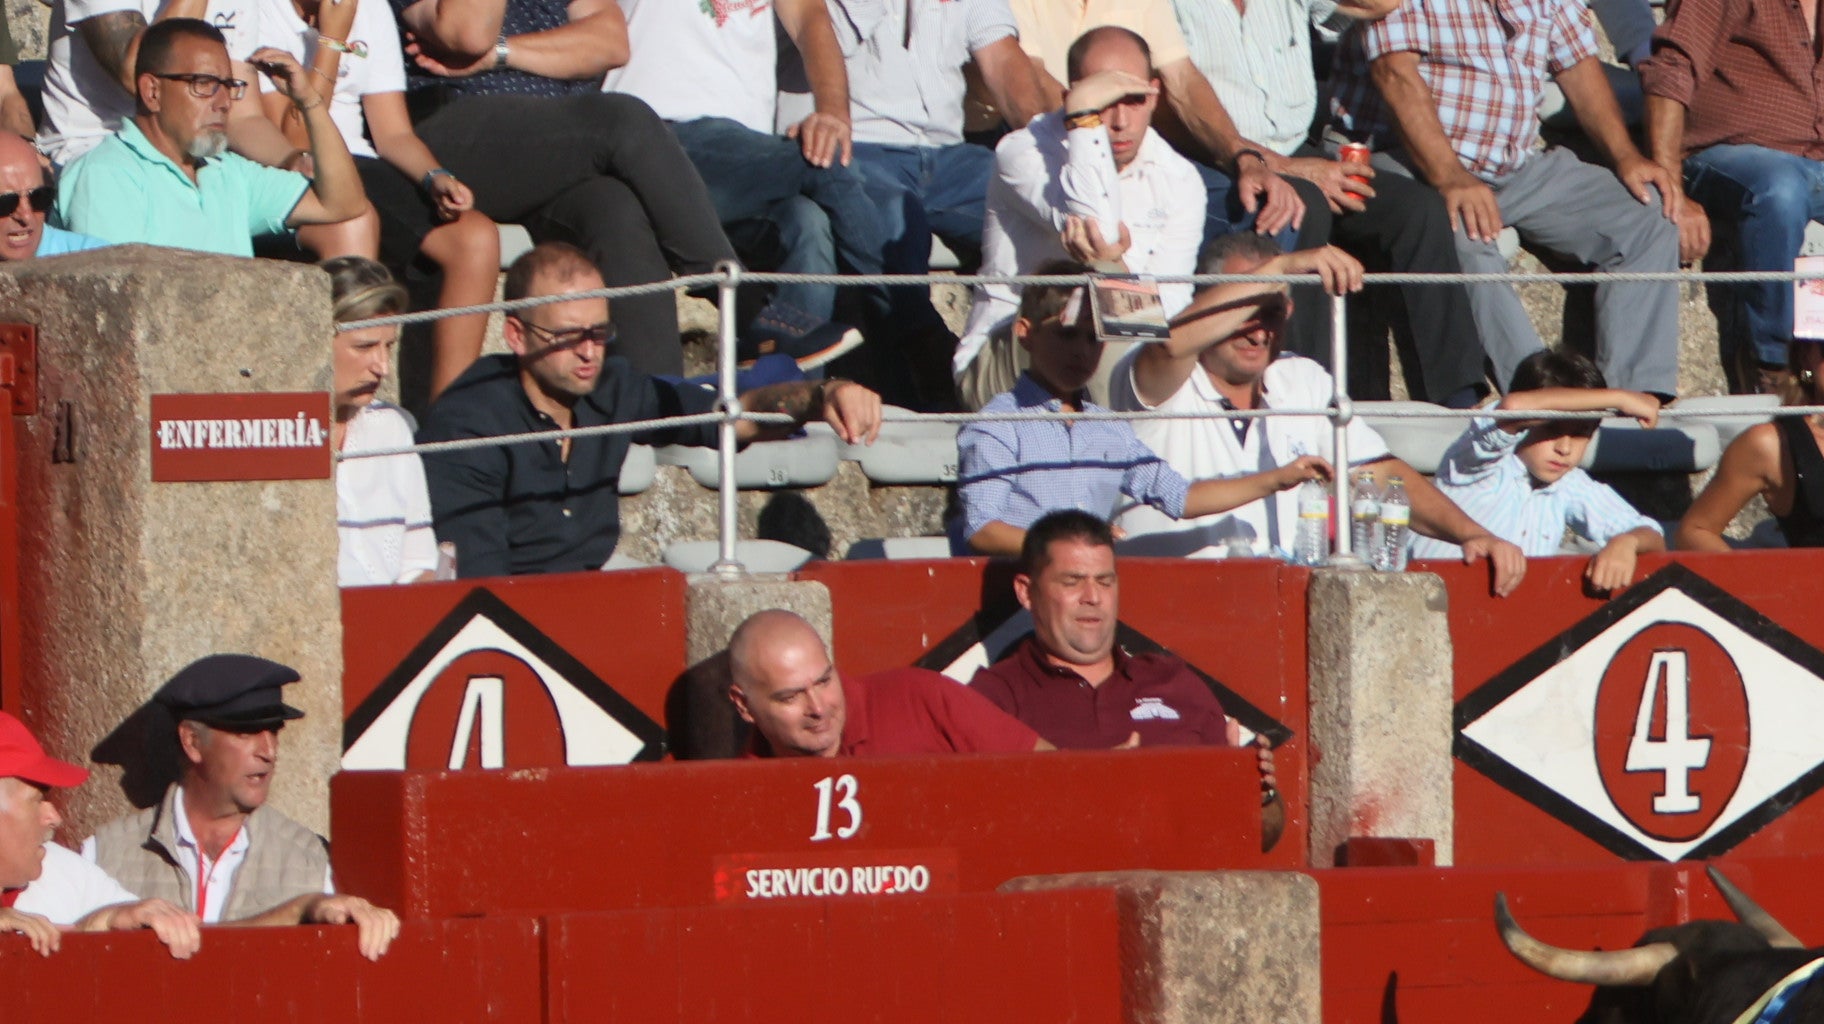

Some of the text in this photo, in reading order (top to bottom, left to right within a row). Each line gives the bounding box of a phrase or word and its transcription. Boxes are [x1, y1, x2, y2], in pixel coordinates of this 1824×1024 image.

[159, 411, 324, 450] ENFERMERÍA
[1625, 650, 1712, 813] 4
[809, 774, 863, 841] 13
[746, 867, 849, 898] SERVICIO
